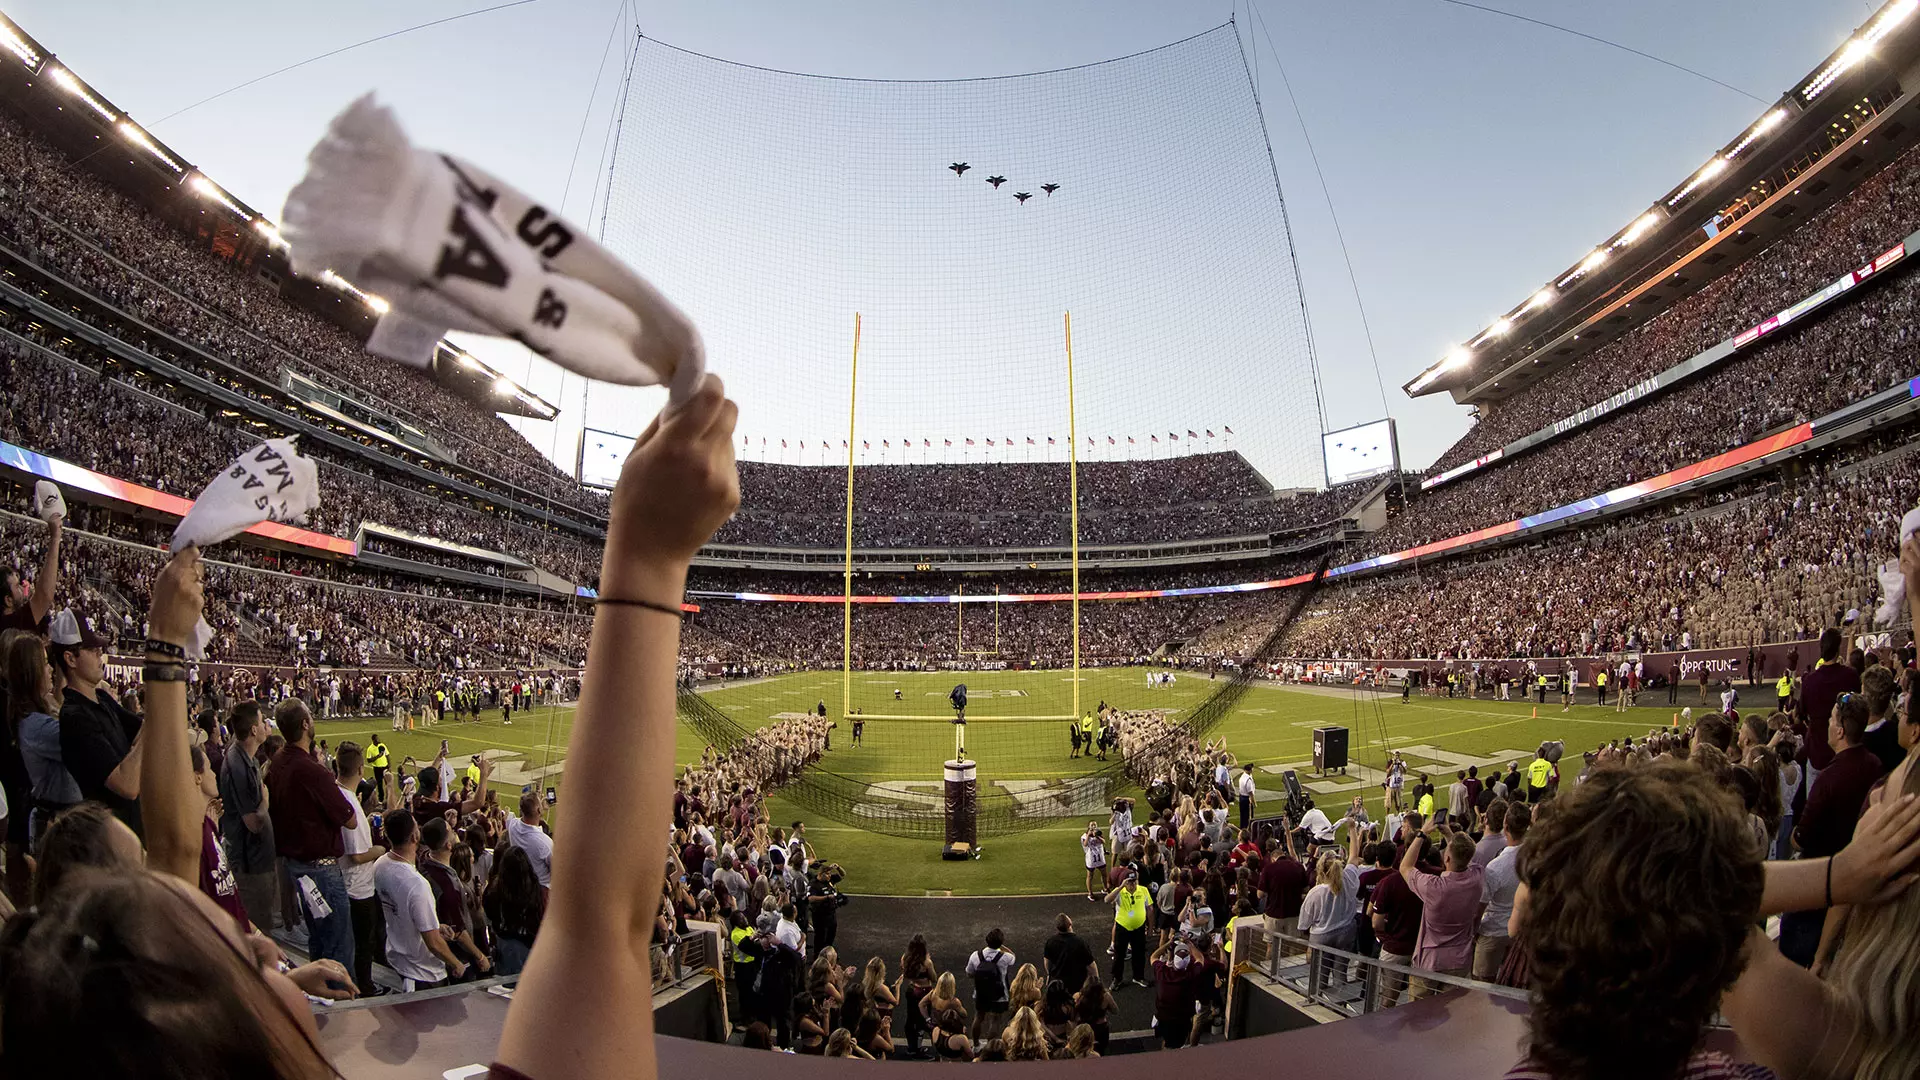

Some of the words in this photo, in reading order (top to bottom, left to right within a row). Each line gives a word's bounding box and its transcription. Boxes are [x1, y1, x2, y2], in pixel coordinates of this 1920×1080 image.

[1553, 415, 1576, 434] HOME
[1578, 410, 1588, 423] OF
[1592, 400, 1610, 417] THE
[1612, 388, 1635, 408] 12TH
[1637, 377, 1659, 395] MAN
[254, 445, 294, 493] MA
